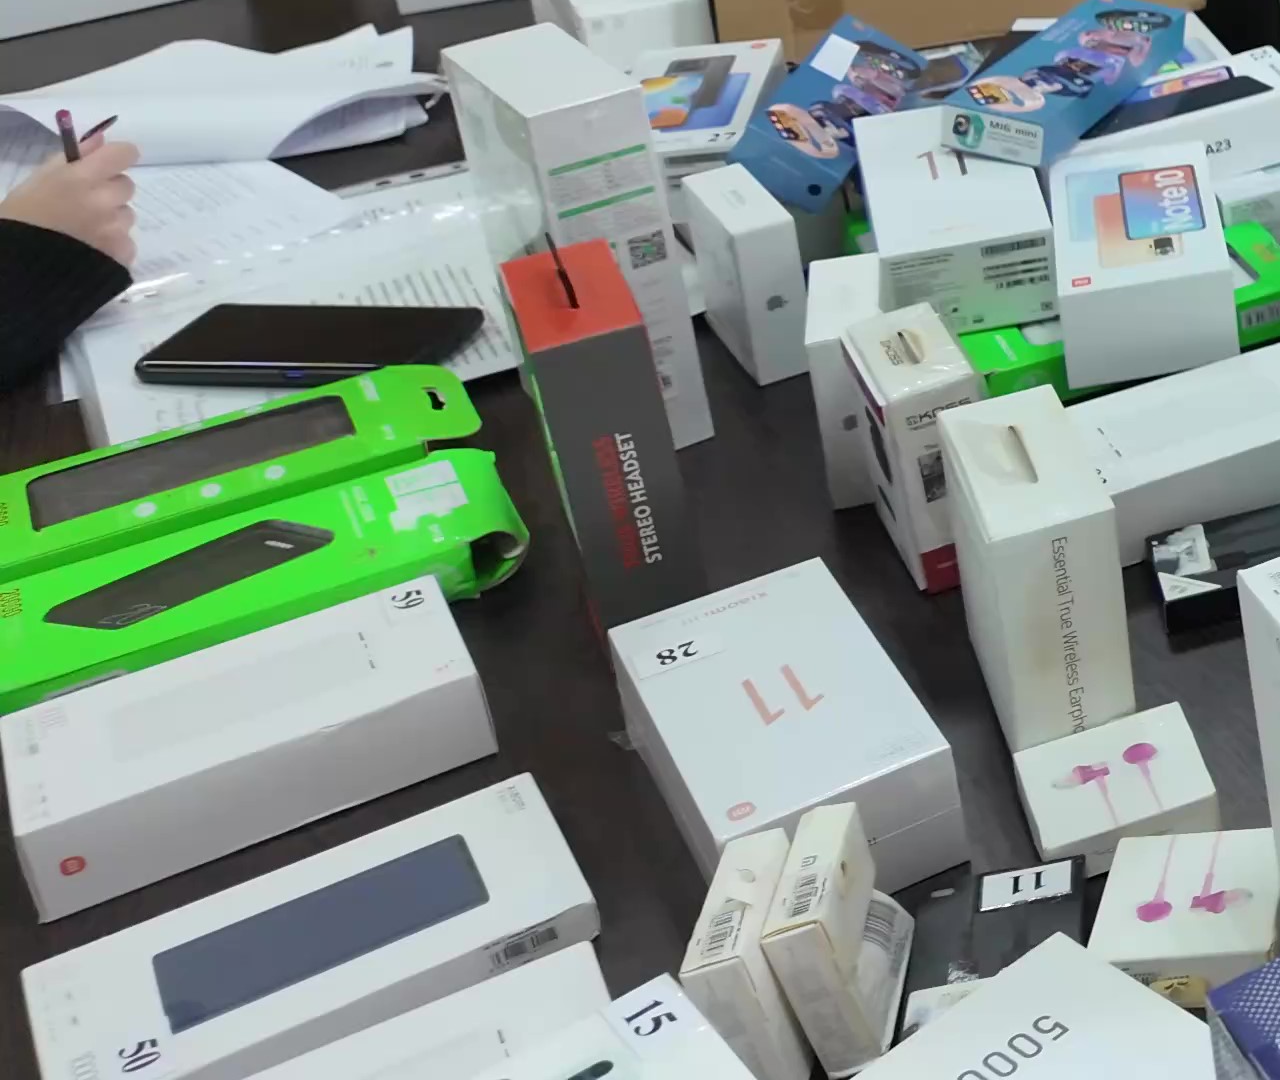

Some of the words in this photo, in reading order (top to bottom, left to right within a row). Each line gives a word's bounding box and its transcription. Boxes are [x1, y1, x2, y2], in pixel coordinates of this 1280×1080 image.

[707, 131, 737, 143] 27
[1205, 138, 1232, 156] A23
[614, 432, 648, 504] HEADSET
[633, 505, 662, 564] STEREO
[1051, 536, 1073, 596] Essential
[390, 589, 425, 610] 59
[1058, 596, 1075, 630] True
[656, 640, 699, 666] 28
[1062, 630, 1081, 686] Wireless
[741, 663, 825, 727] 11
[1009, 870, 1047, 895] 11
[624, 999, 678, 1037] 15
[118, 1038, 161, 1073] 50
[956, 1015, 1070, 1080] 500
